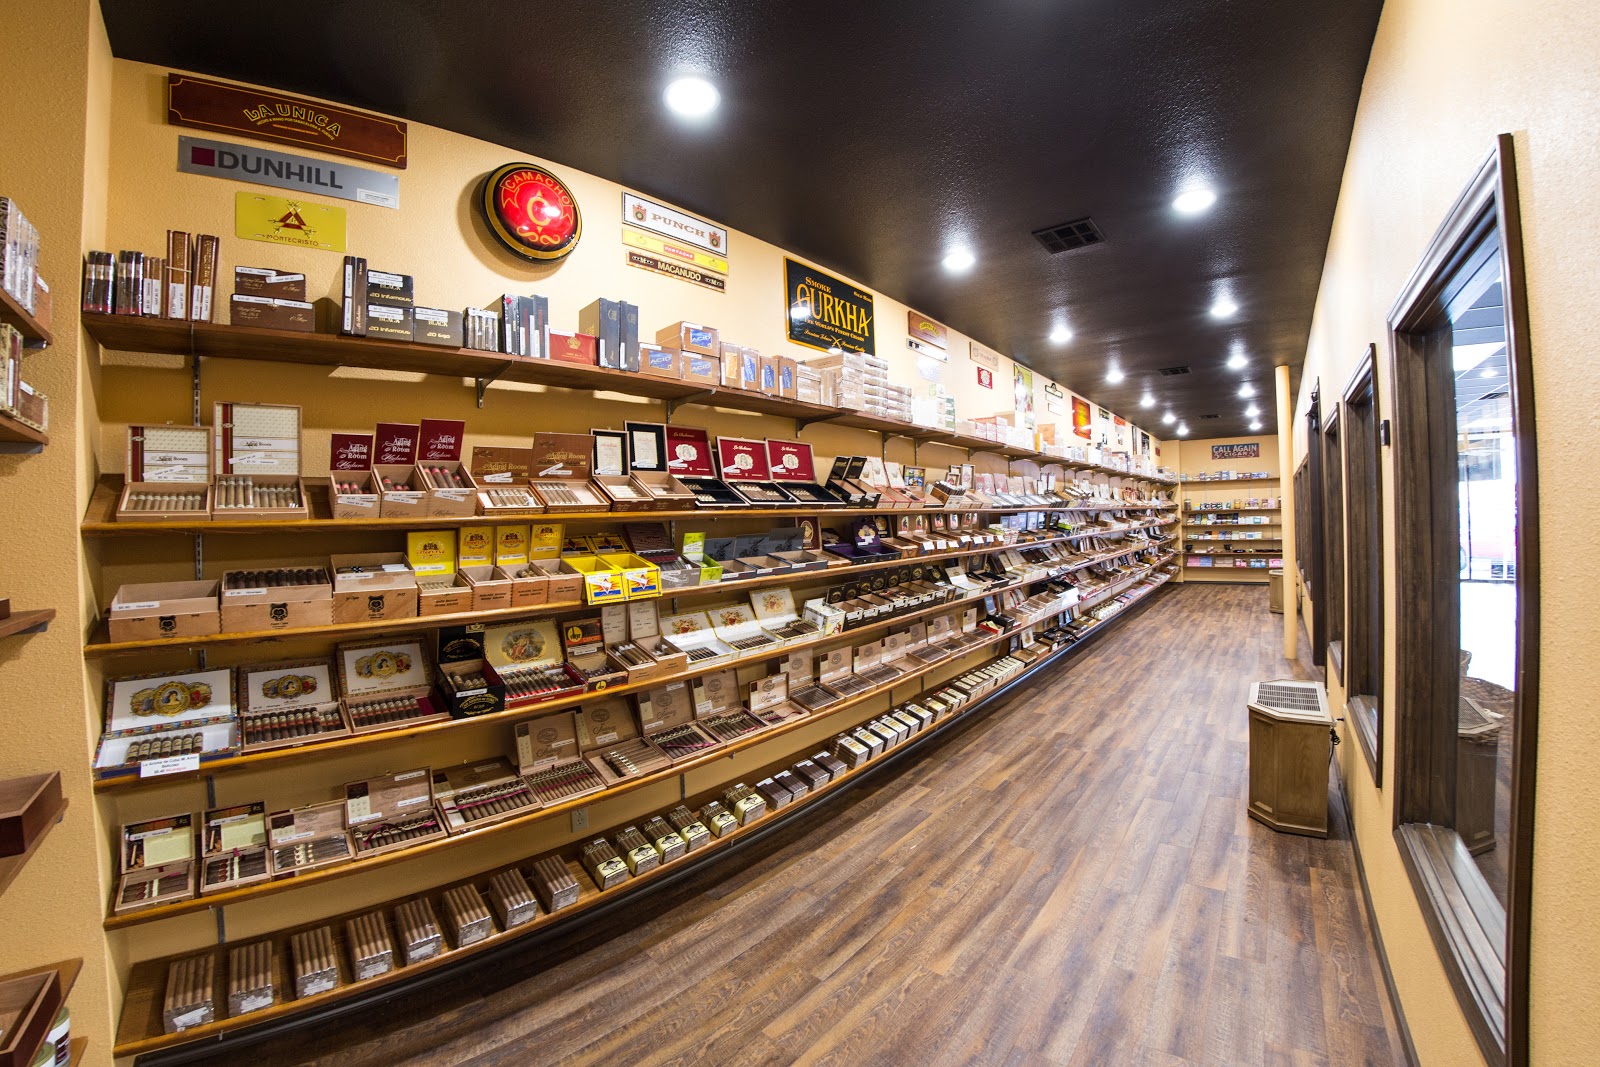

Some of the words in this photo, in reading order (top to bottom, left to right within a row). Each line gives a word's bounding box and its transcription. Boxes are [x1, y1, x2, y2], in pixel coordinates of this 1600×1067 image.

[243, 104, 274, 122] LA
[276, 104, 341, 136] UNICA
[218, 150, 343, 190] DUNHILL
[505, 171, 570, 206] CAMACHO
[651, 211, 706, 239] PUNCH
[266, 233, 319, 247] MONTECRISTO
[657, 260, 702, 282] MACANUDO
[791, 283, 873, 338] GURKHA
[650, 356, 672, 364] ACID
[691, 364, 711, 372] ACID
